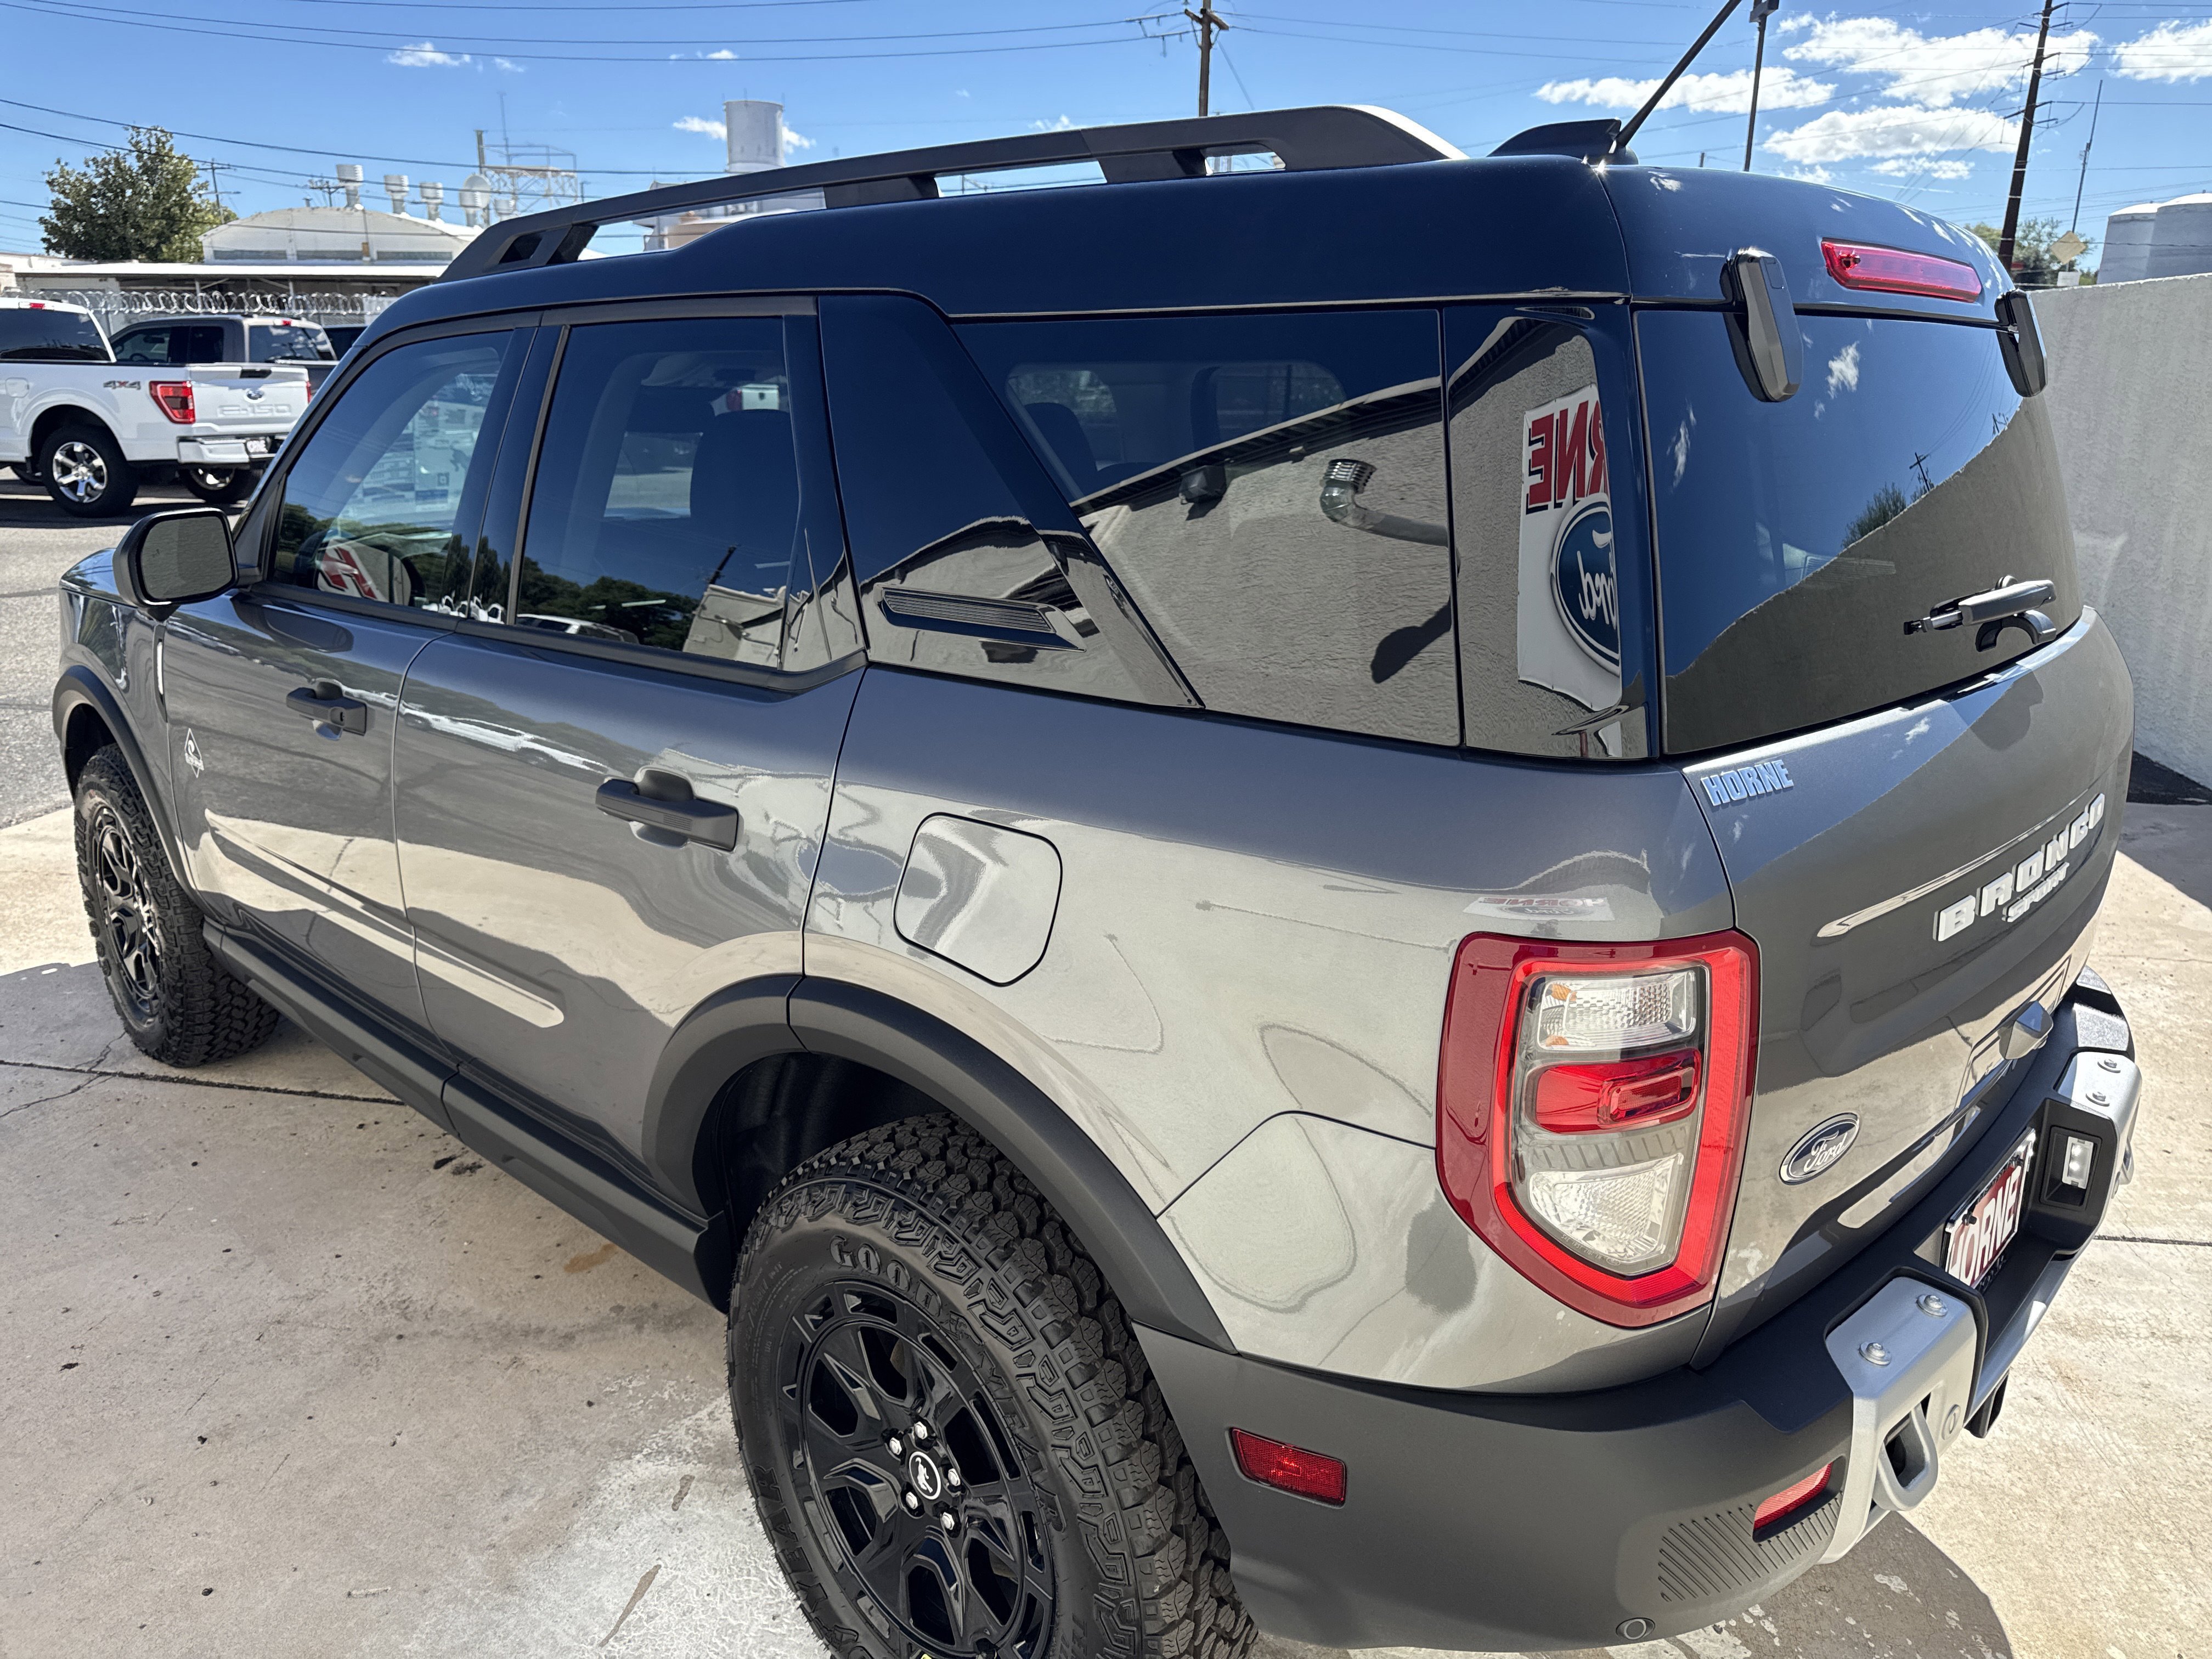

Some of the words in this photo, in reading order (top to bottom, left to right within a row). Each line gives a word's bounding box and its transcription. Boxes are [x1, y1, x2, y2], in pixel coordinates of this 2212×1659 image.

[1701, 759, 1794, 806] HORNE
[1933, 793, 2105, 941] BRONCO
[2002, 862, 2070, 922] SPORT
[1804, 1130, 1848, 1172] Ford
